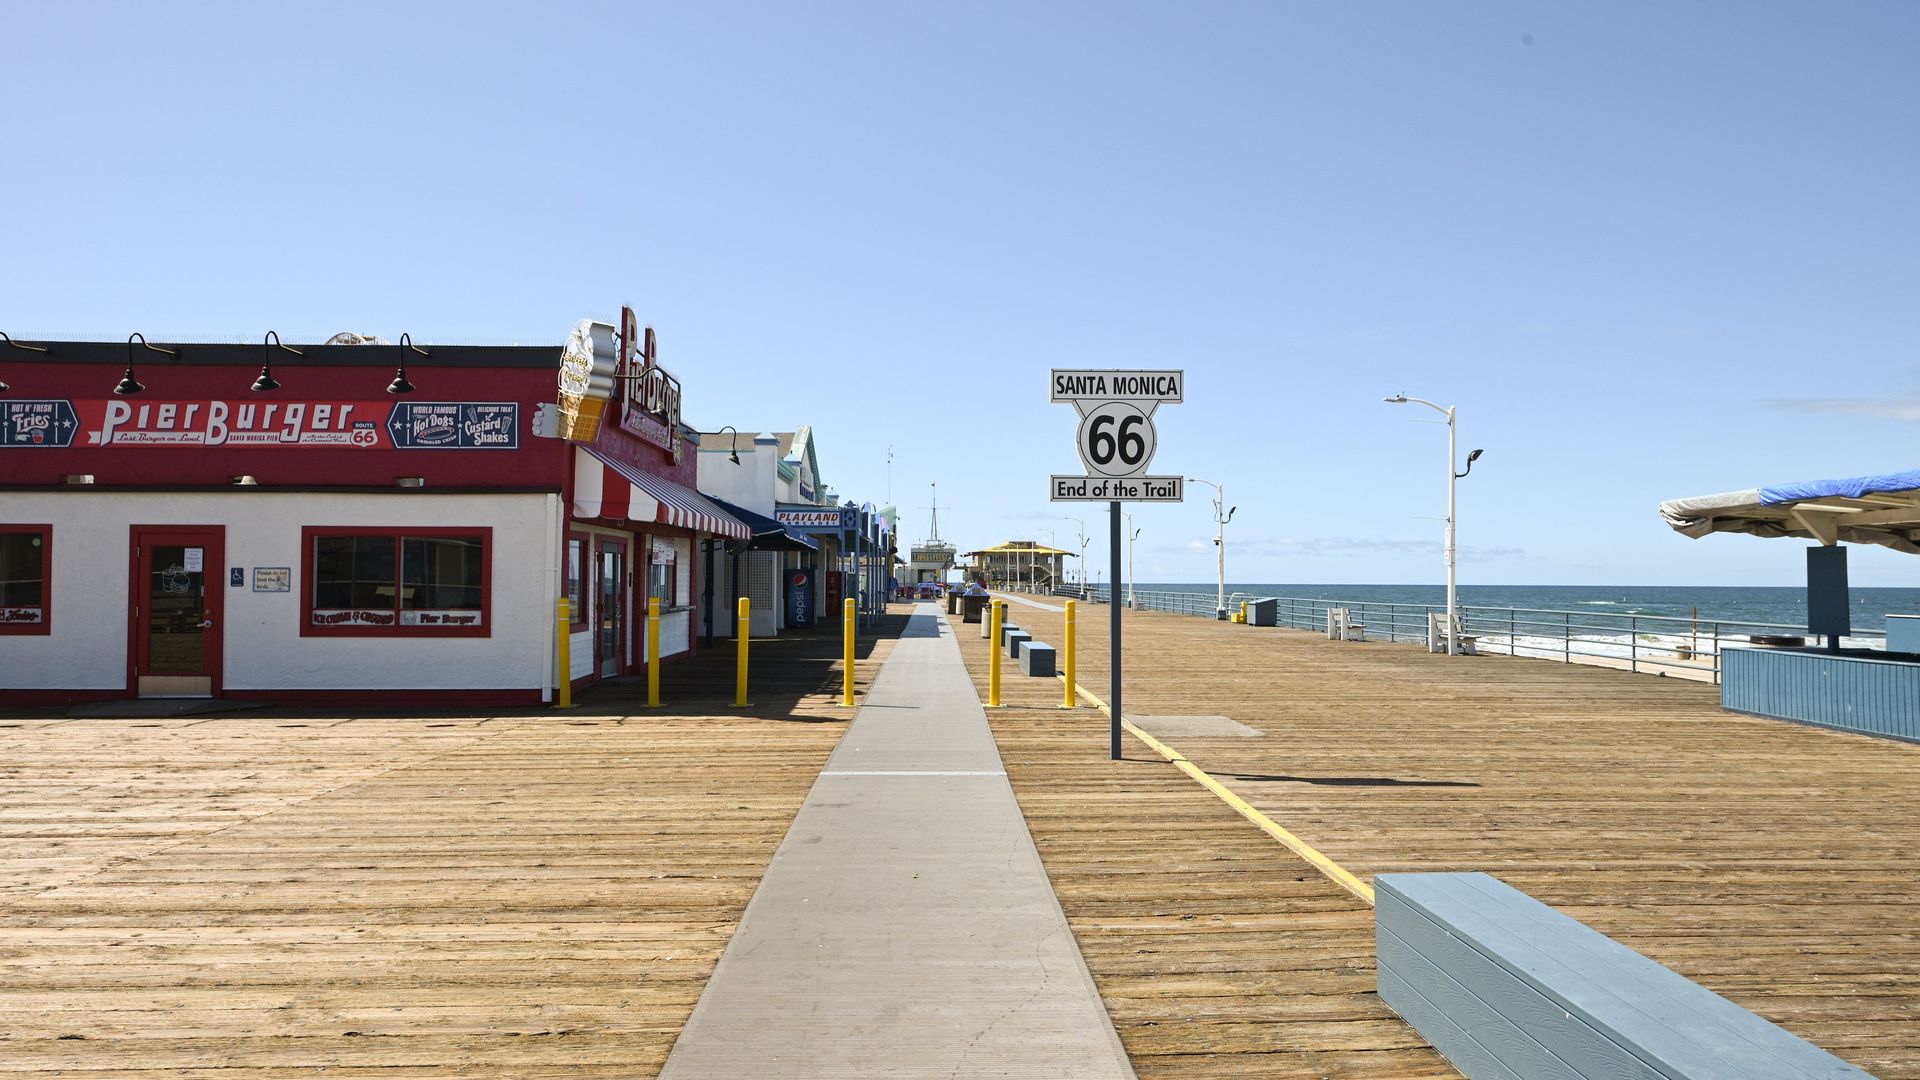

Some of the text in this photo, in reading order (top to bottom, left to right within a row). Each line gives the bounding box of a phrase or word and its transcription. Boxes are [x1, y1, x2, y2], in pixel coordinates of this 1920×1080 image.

[1056, 375, 1178, 396] SANTA MONICA
[11, 404, 24, 413] HOT
[33, 404, 52, 413] FRESH
[413, 406, 457, 414] WORLD FAMOUS
[11, 413, 51, 433] Fries
[413, 414, 454, 437] Hot Dogs
[464, 417, 501, 436] Custard
[117, 433, 137, 441] Last
[138, 433, 167, 443] Burger
[178, 433, 201, 441] Land
[230, 434, 279, 442] SANTA MONICA PIER
[353, 431, 375, 443] 66
[474, 432, 509, 446] Shakes
[1088, 414, 1145, 466] 66
[1057, 480, 1176, 497] End of the Trail
[778, 513, 839, 522] PLAYLAND
[794, 591, 806, 623] pepsi
[420, 613, 477, 625] Pier Burger
